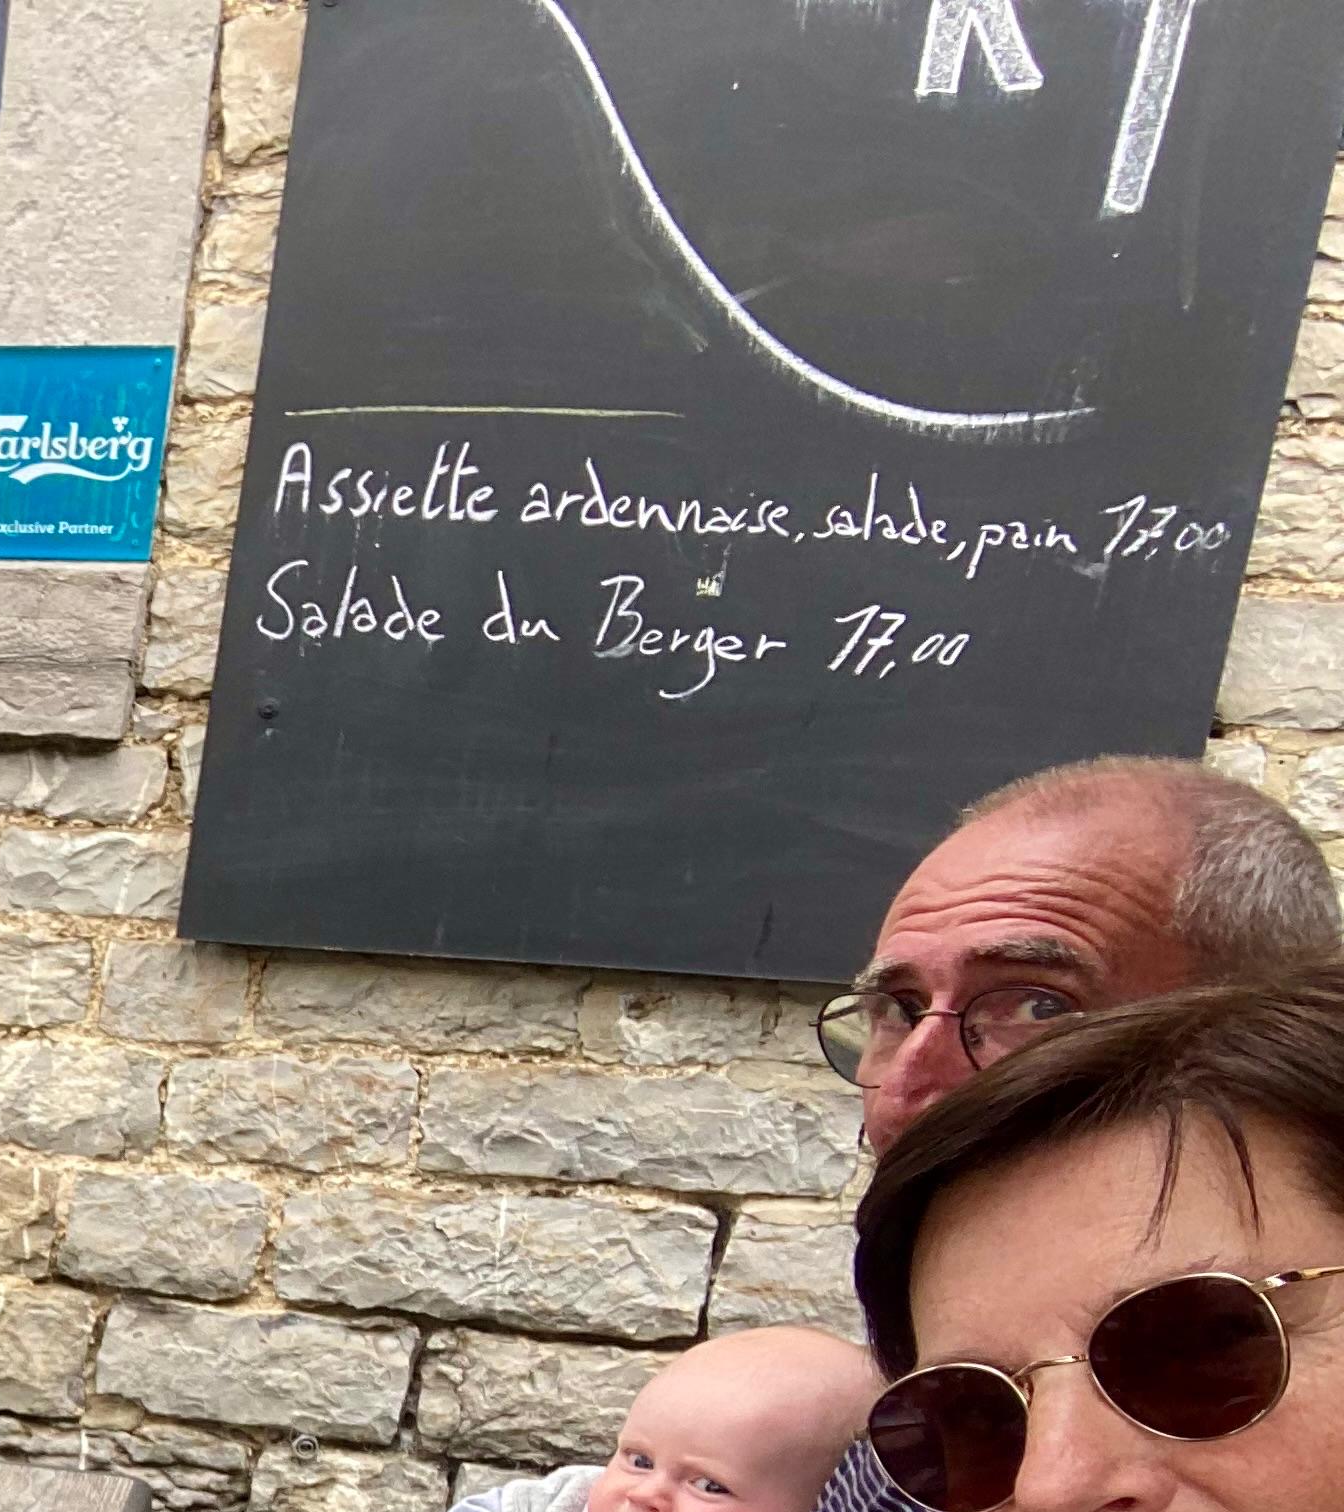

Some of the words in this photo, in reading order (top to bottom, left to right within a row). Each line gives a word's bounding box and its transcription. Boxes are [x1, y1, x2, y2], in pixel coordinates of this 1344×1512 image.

[274, 441, 499, 522] Assiette
[58, 520, 114, 535] Partner
[256, 559, 445, 640] Salade
[482, 570, 561, 645] du
[592, 574, 787, 700] Berger
[828, 604, 971, 680] 17,00
